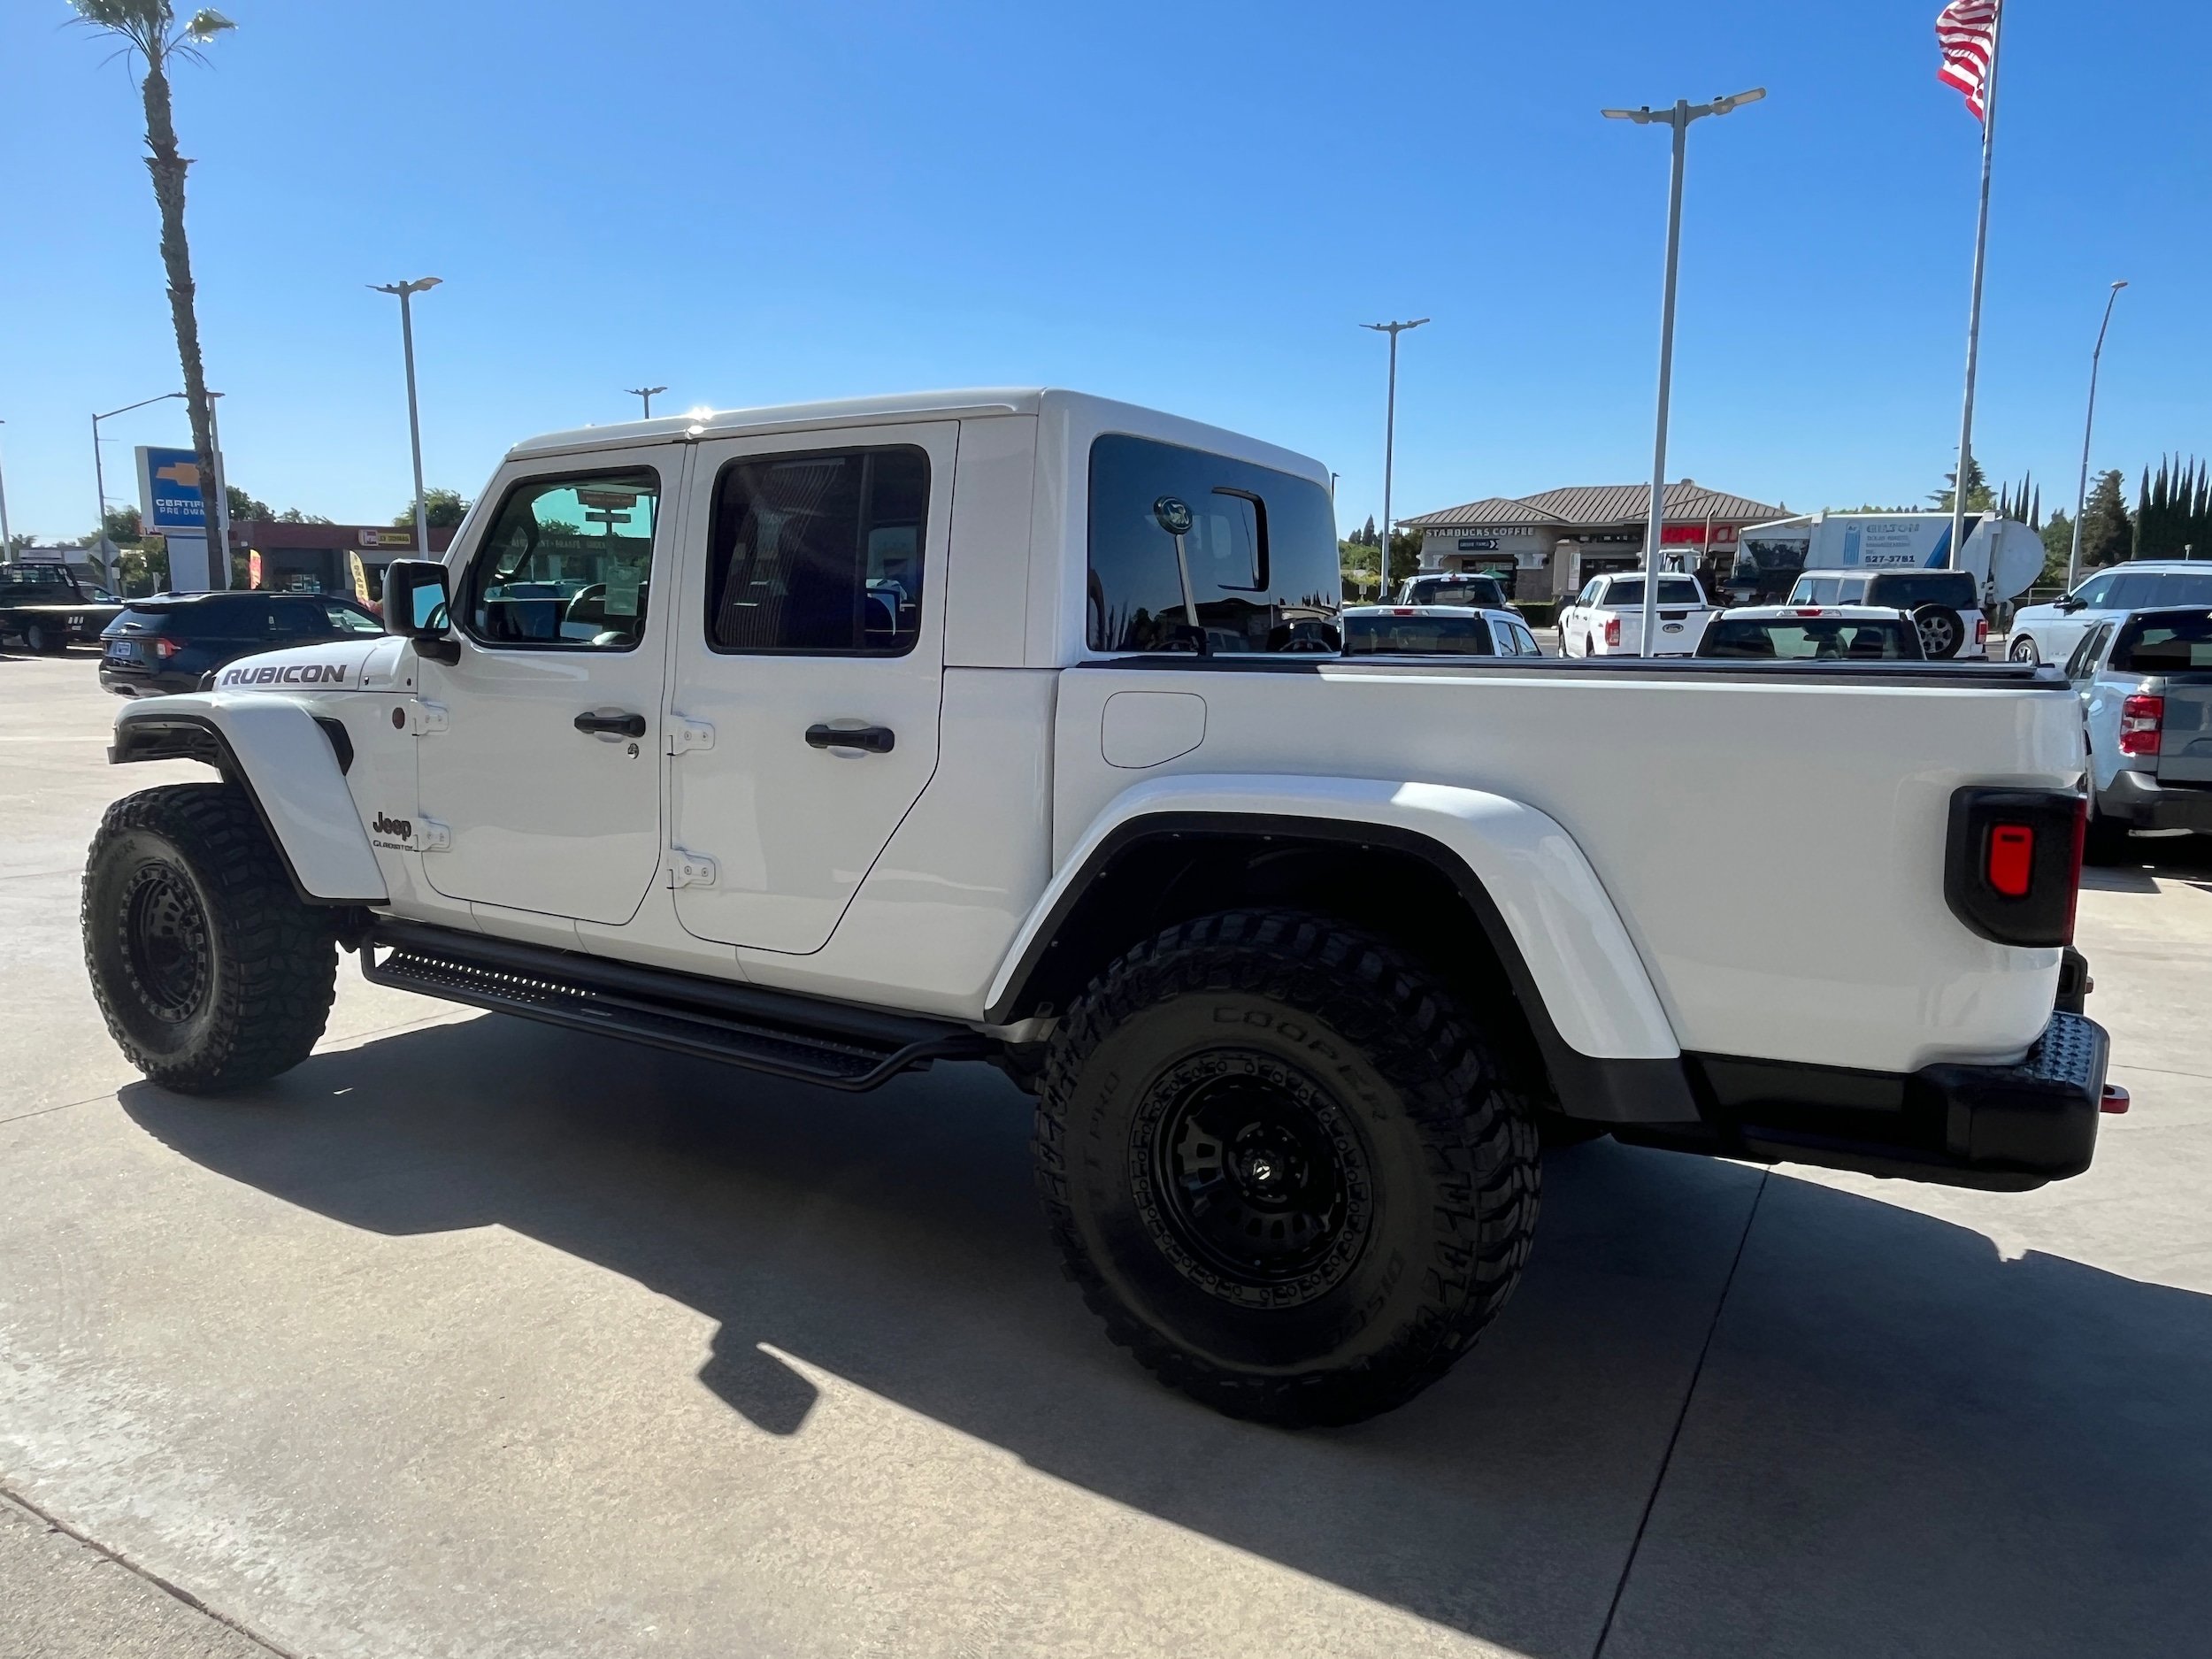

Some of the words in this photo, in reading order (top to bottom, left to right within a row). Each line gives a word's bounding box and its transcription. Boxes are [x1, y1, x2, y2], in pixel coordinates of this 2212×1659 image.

[156, 498, 204, 509] CERTIFI
[1425, 527, 1490, 537] STARBUCKS
[1492, 526, 1534, 536] COFFEE
[221, 664, 348, 686] RUBICON
[373, 811, 412, 841] Jeep
[1213, 1006, 1387, 1121] COOPER
